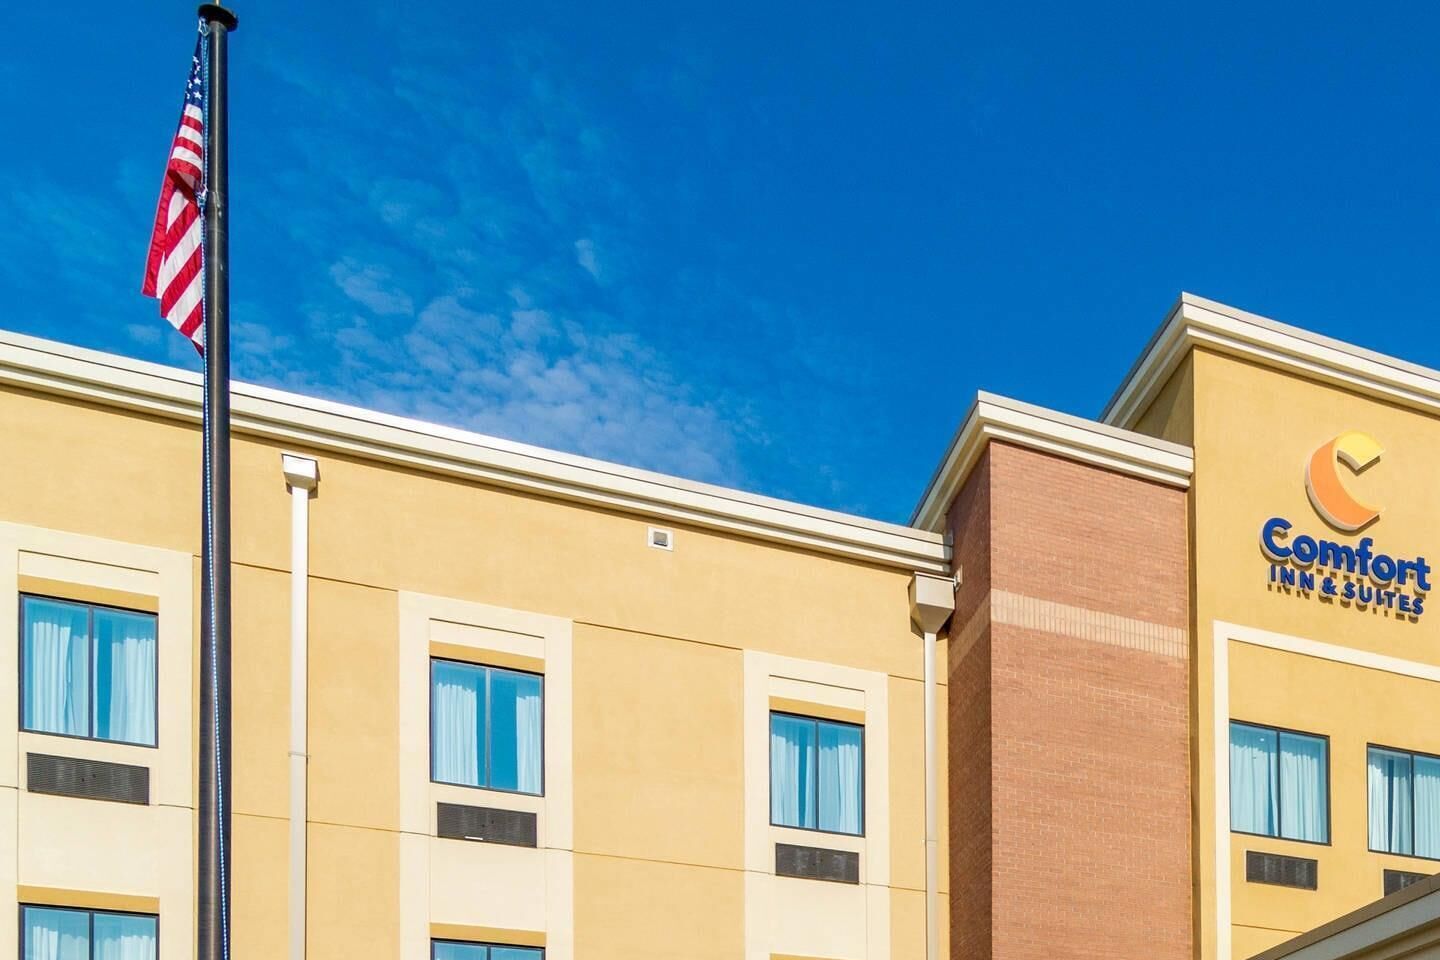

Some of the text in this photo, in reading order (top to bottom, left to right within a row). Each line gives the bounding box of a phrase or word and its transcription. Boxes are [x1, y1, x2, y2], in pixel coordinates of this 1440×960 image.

[1261, 517, 1431, 592] Comfort
[1270, 564, 1424, 616] INN & SUITES
